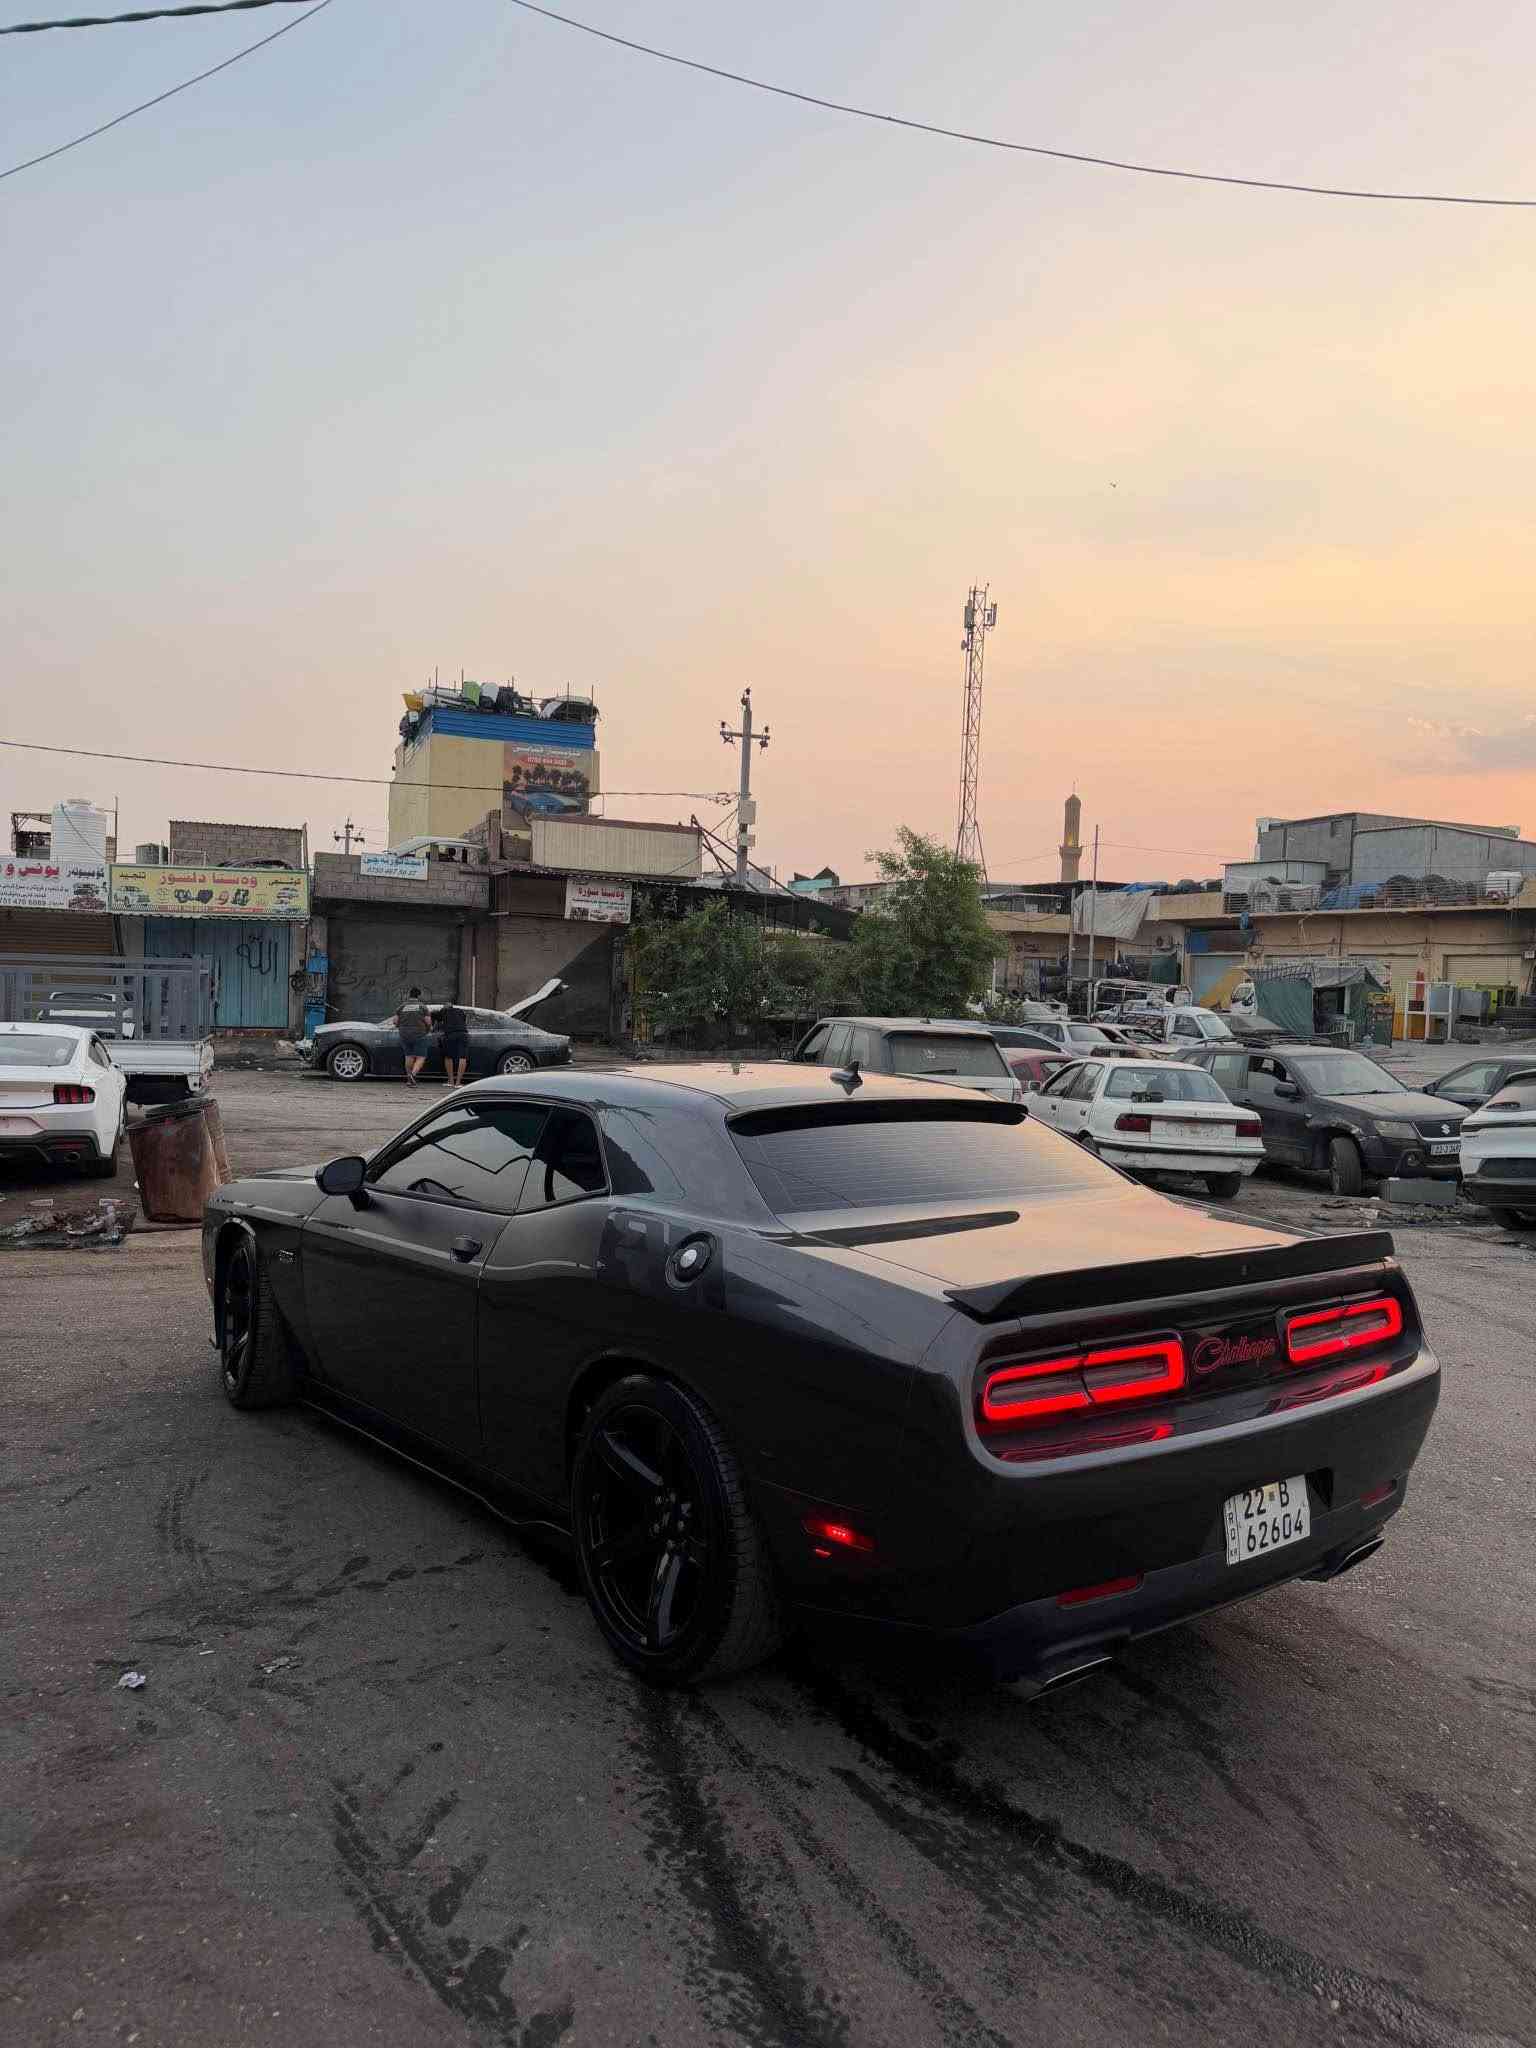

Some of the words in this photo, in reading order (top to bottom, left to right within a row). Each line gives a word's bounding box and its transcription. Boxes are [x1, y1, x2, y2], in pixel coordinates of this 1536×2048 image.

[1243, 1487, 1266, 1519] 22
[1279, 1480, 1289, 1508] B
[1247, 1508, 1303, 1552] 62604
